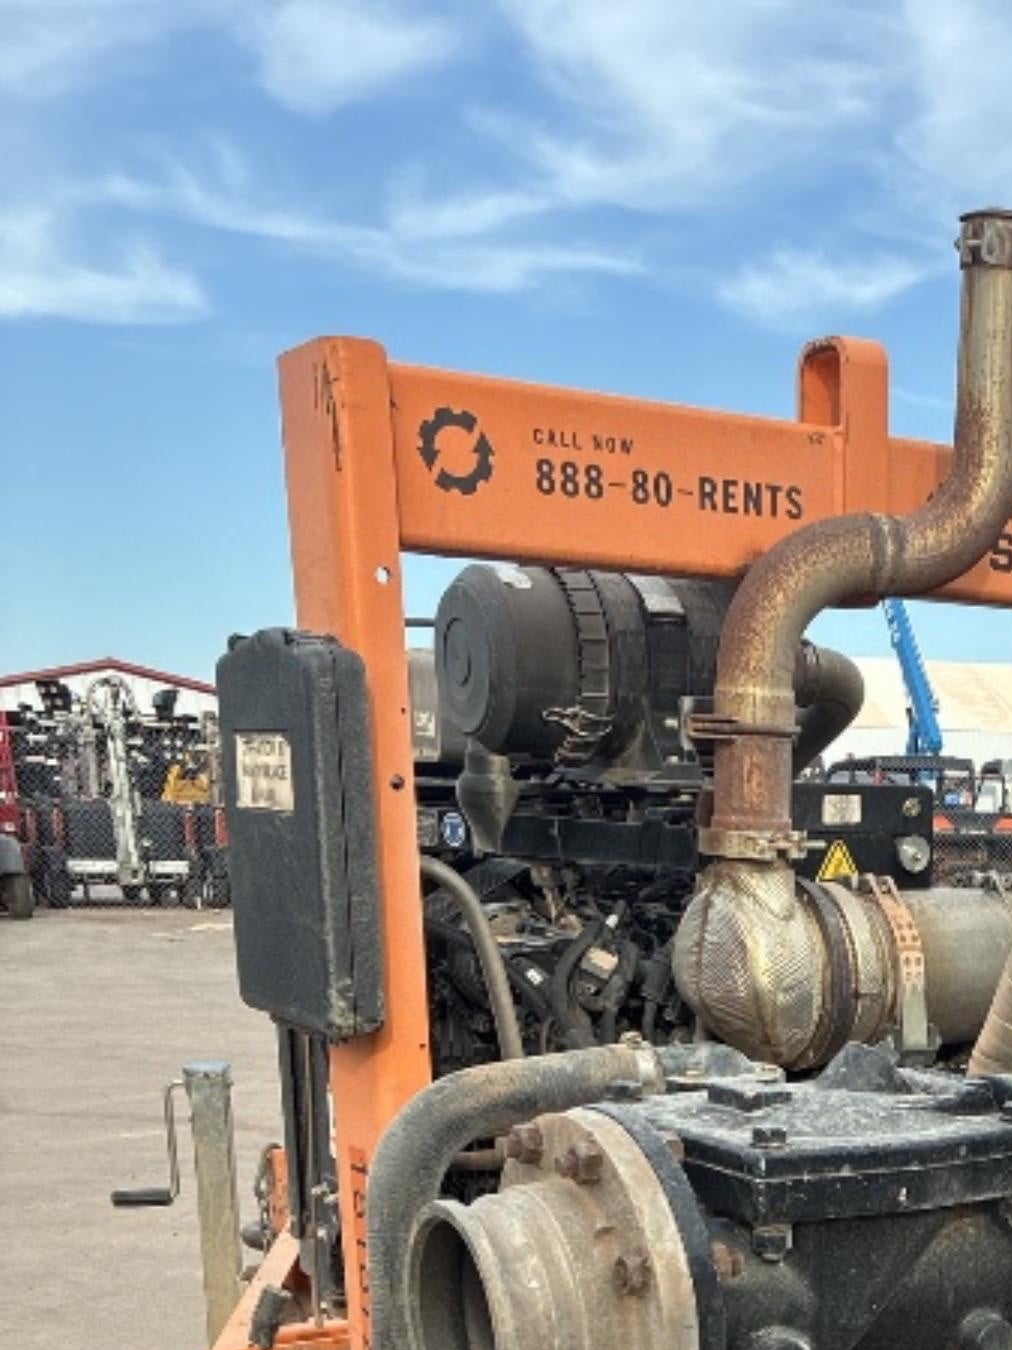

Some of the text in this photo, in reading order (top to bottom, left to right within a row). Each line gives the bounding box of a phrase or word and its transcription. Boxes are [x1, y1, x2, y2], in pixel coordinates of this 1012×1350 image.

[532, 428, 635, 455] CALL NOW
[535, 458, 804, 520] 888-80-RENTS
